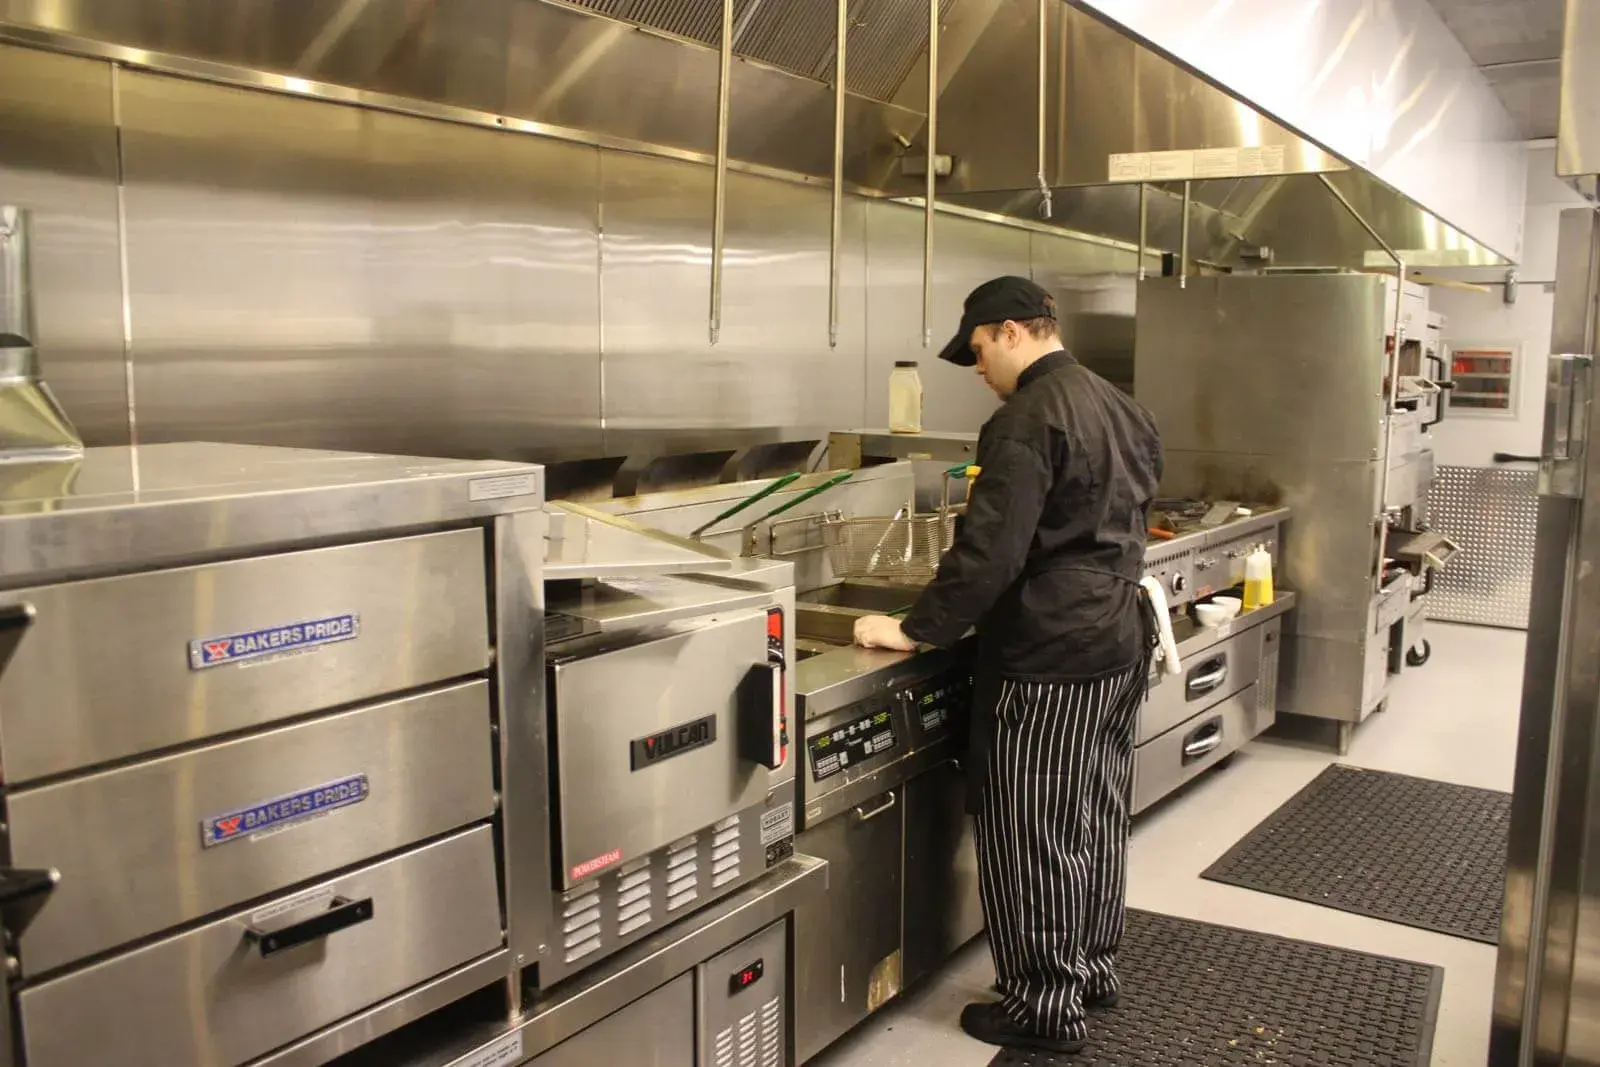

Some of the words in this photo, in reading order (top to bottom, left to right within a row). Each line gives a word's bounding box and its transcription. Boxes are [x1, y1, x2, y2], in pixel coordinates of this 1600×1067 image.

[234, 627, 302, 653] BAKERS
[304, 618, 351, 640] PRIDE
[642, 721, 709, 759] VULCAN
[245, 796, 313, 828] BAKERS
[314, 781, 360, 807] PRIDE
